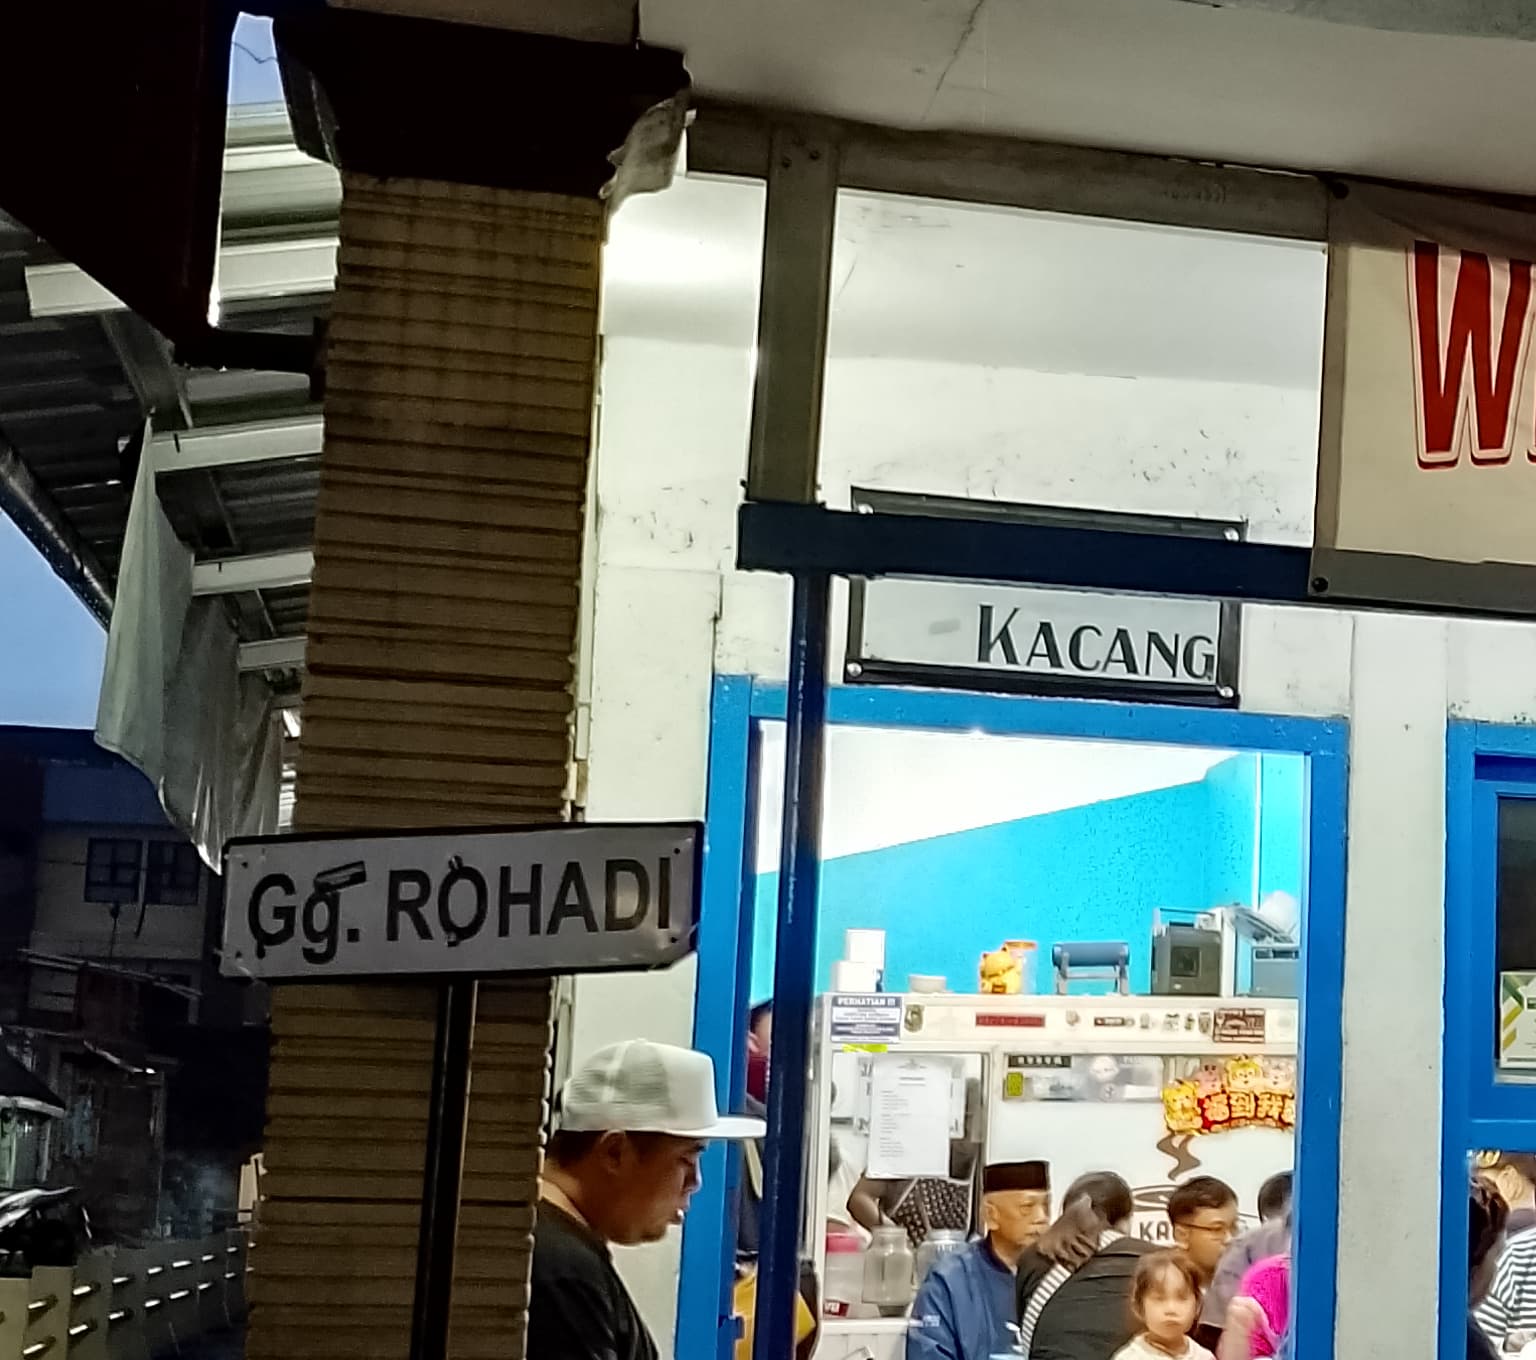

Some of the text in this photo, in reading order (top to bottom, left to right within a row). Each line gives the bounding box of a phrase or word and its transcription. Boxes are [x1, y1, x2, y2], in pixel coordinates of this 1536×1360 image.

[976, 603, 1216, 681] KACANG
[246, 856, 673, 965] Gg. ROHADI
